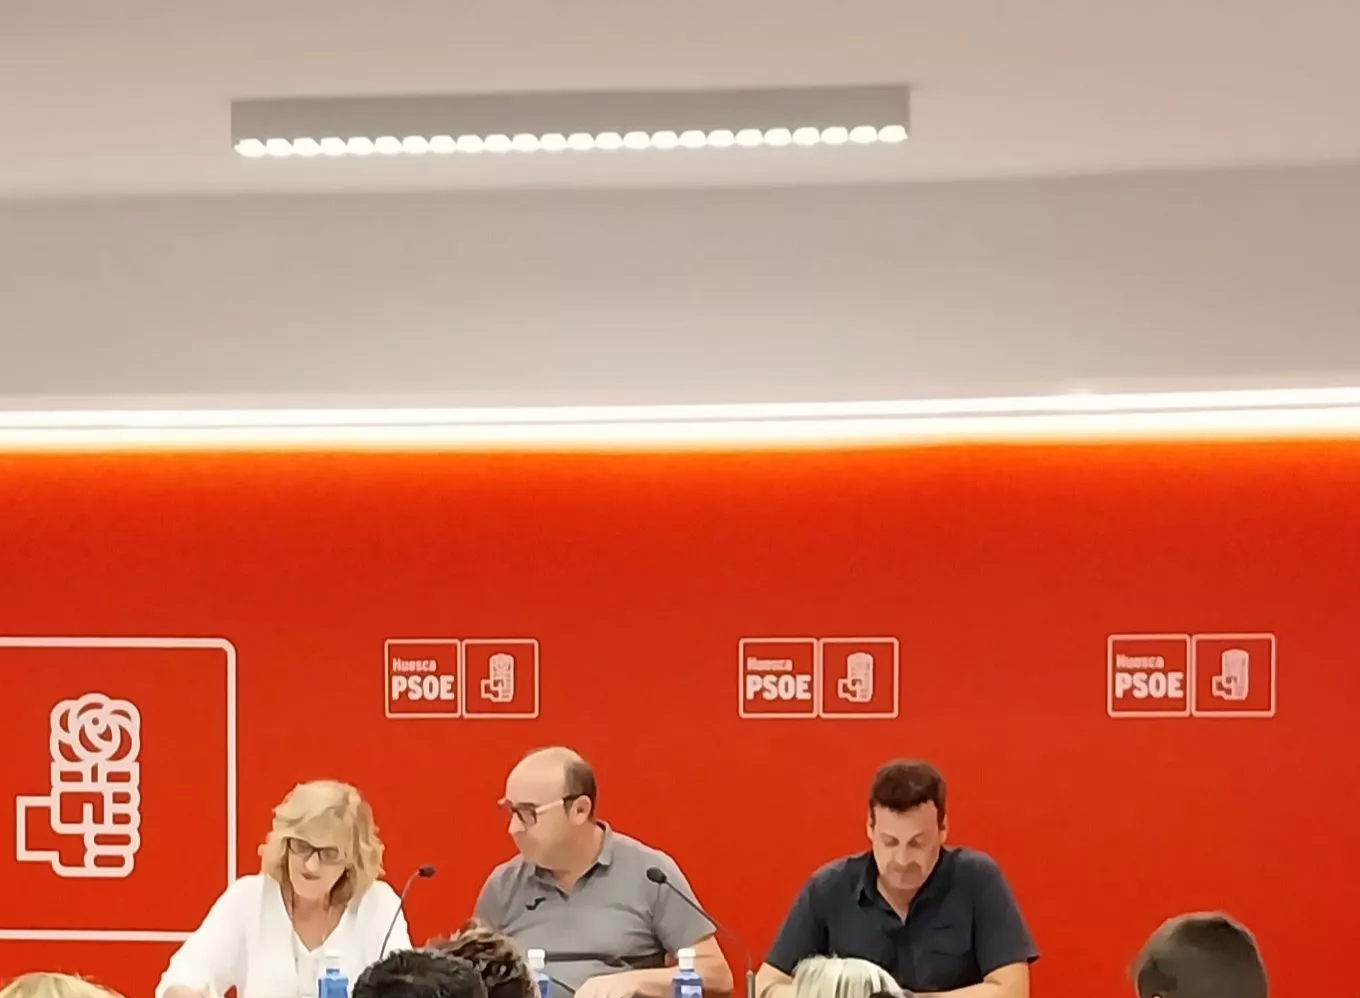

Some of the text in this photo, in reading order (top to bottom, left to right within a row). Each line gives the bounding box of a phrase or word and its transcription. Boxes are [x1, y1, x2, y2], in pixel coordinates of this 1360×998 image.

[391, 674, 455, 701] PSOE
[745, 674, 812, 701] PSOE
[1114, 671, 1184, 699] PSOE
